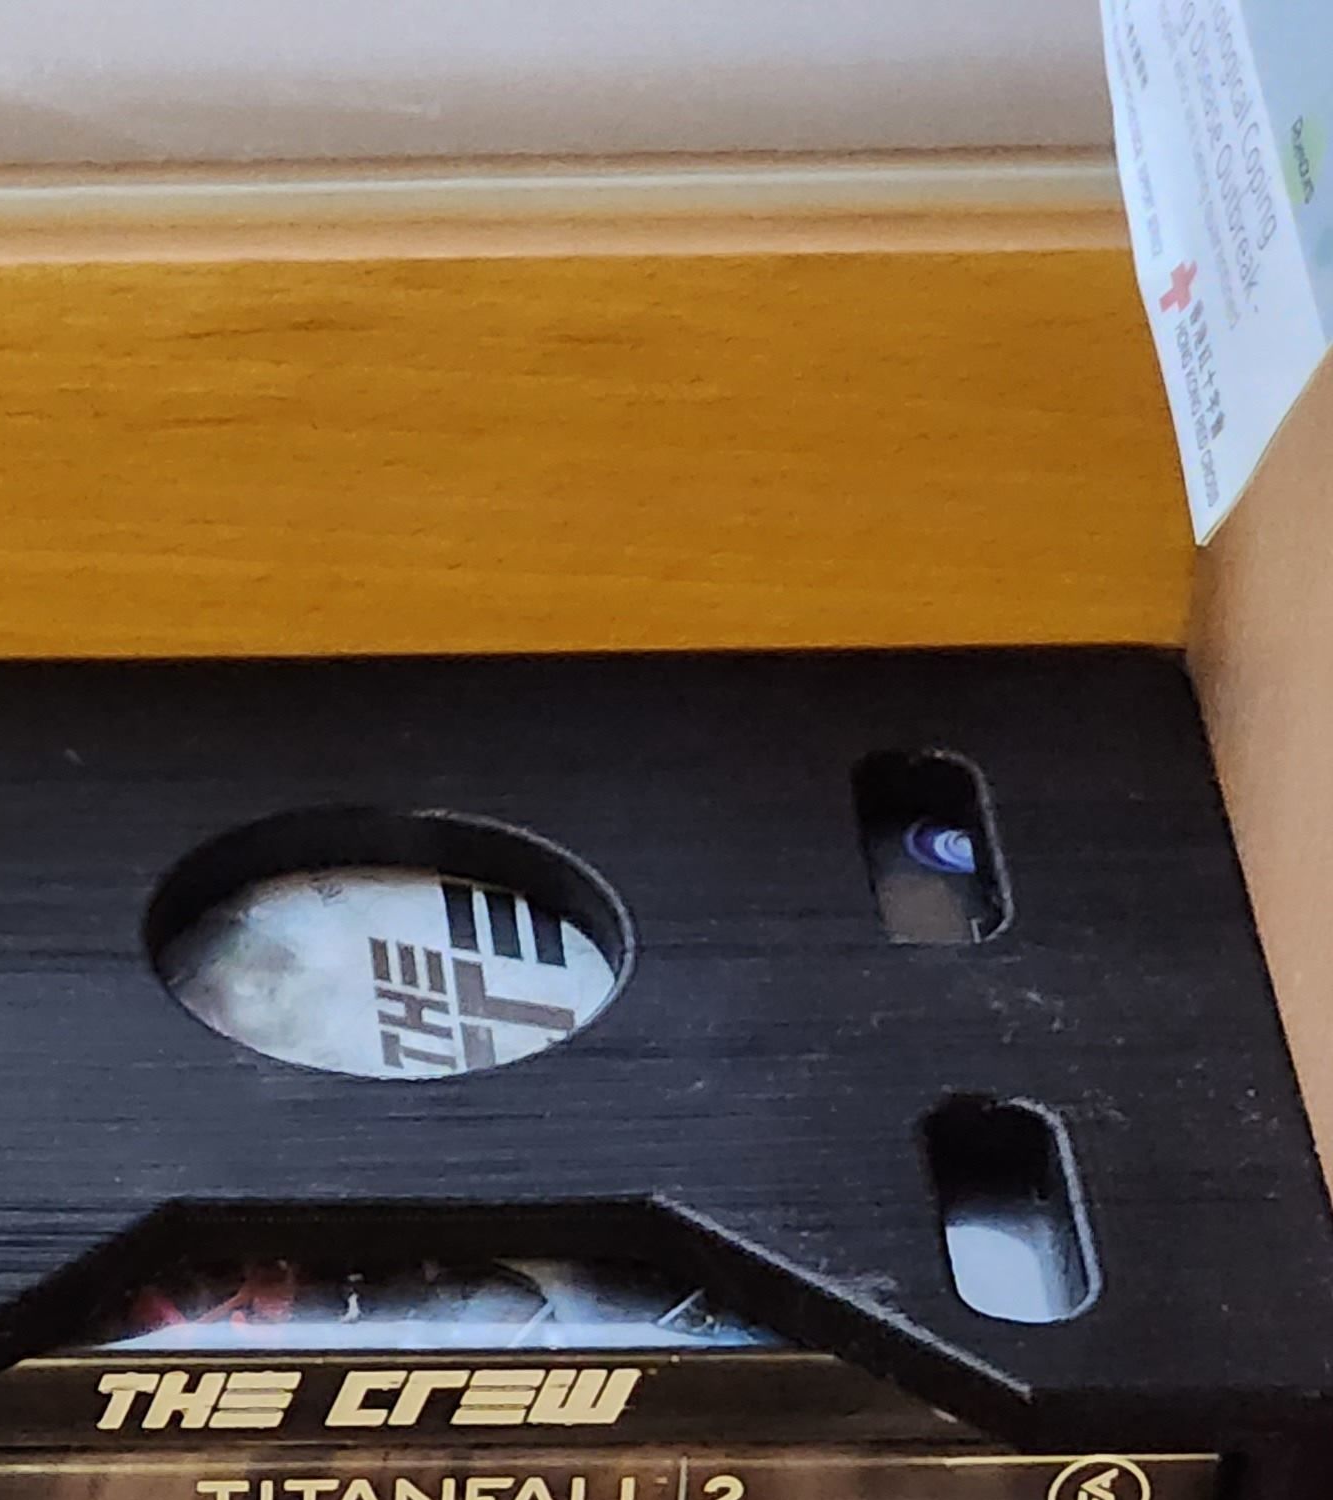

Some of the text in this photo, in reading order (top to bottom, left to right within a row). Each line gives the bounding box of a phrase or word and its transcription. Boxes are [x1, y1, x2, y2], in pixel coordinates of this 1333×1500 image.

[1240, 120, 1277, 250] Coping
[96, 1368, 649, 1431] THE CREW
